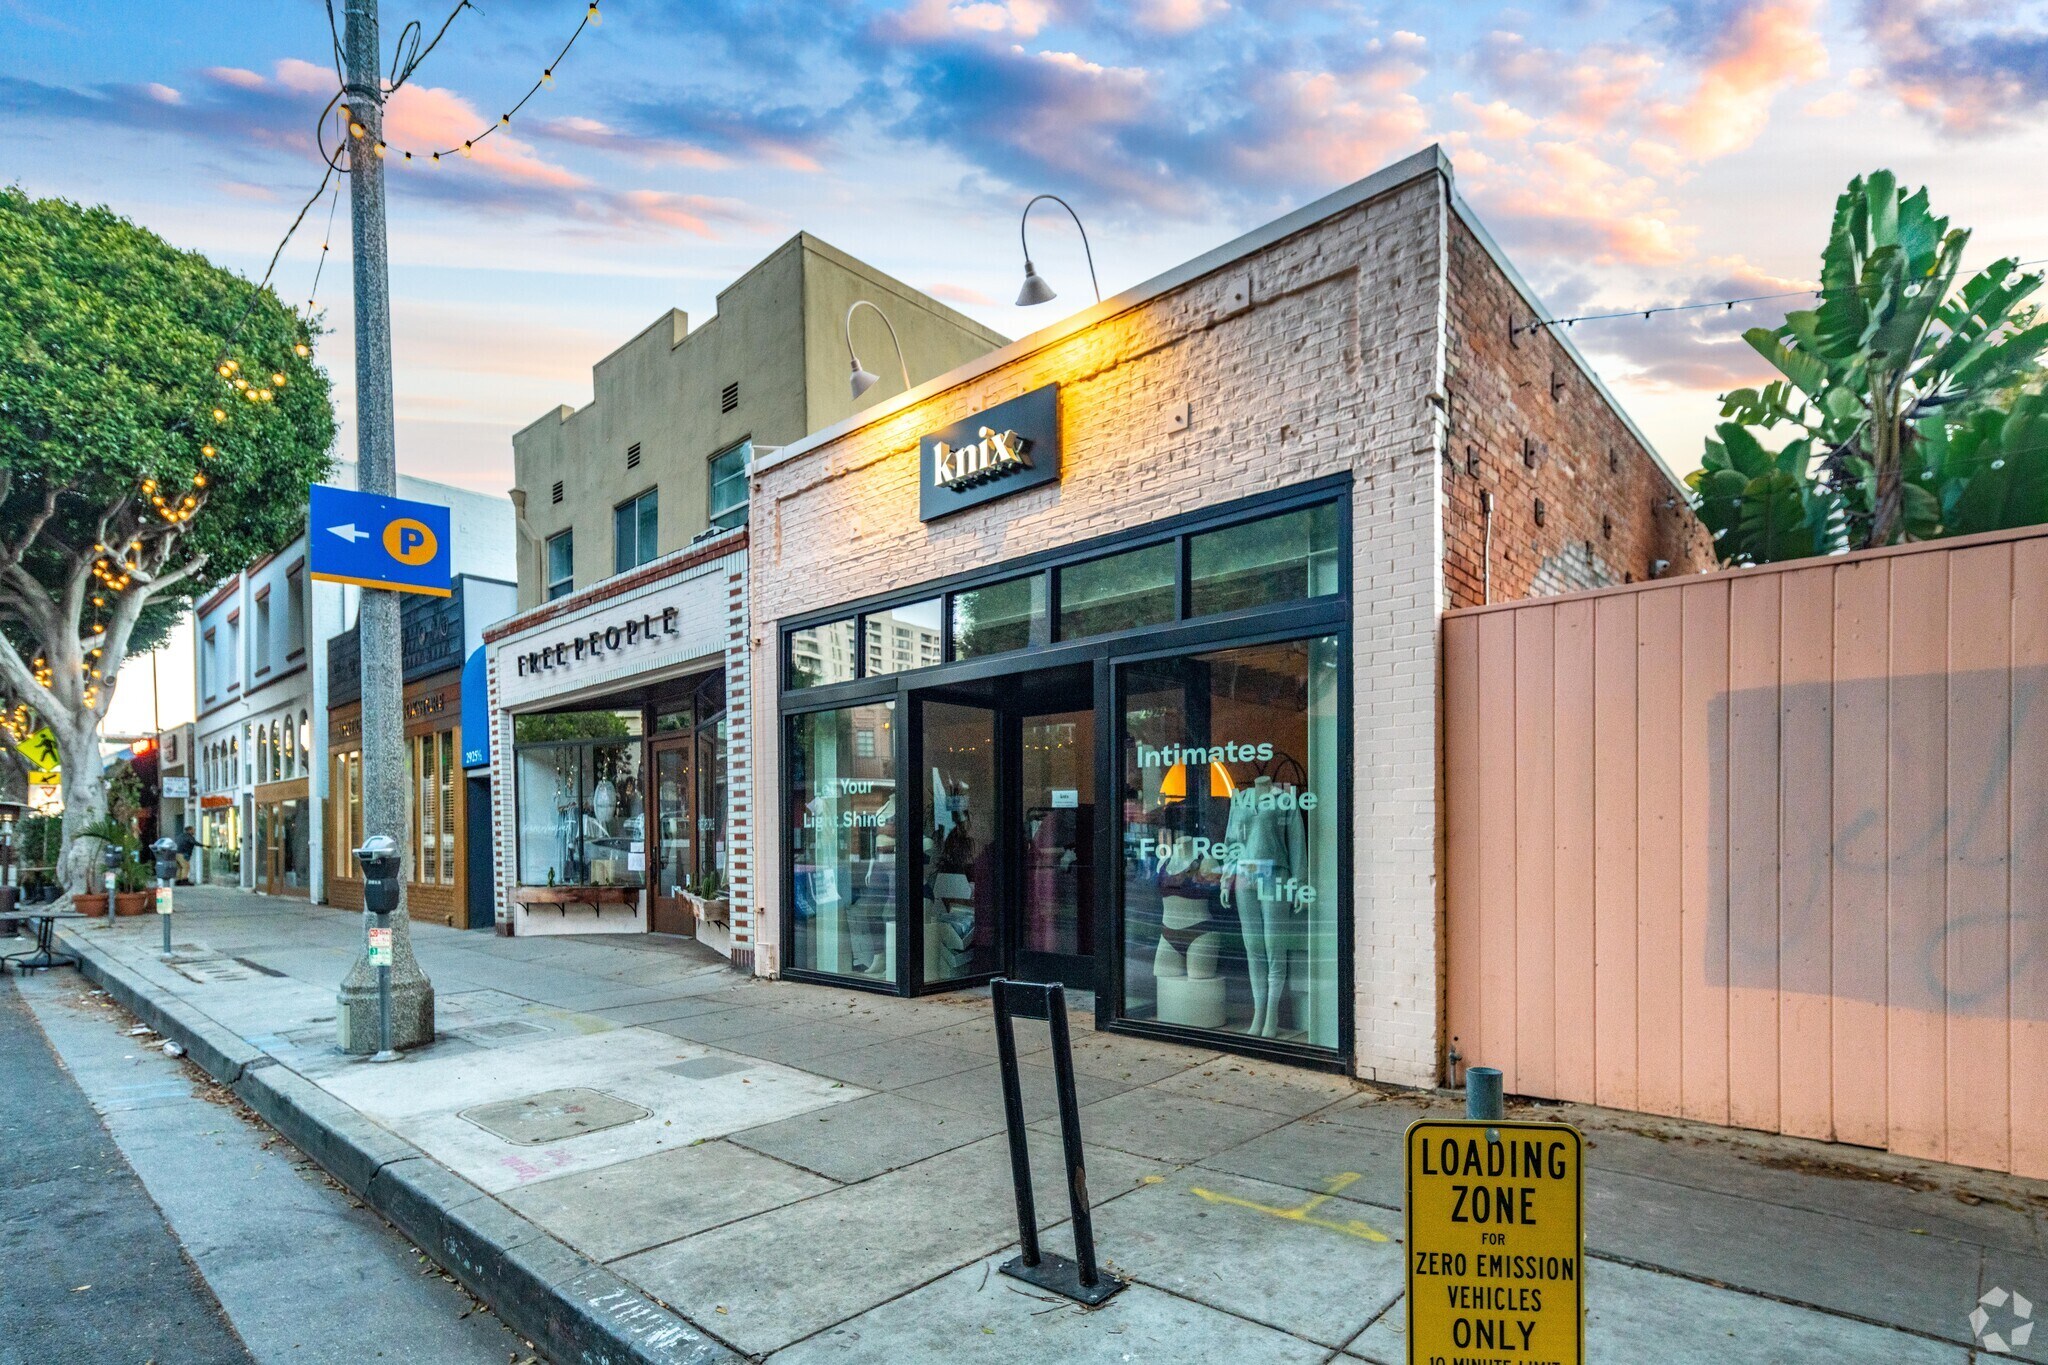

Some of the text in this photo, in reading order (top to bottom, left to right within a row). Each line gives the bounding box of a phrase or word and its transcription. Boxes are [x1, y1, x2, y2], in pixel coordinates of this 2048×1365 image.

[934, 426, 1019, 486] knix
[400, 527, 424, 555] P
[517, 607, 679, 677] FREE PEOPLE
[1137, 741, 1274, 768] Intimates
[840, 778, 874, 795] Your
[1231, 786, 1318, 811] Made
[843, 811, 886, 828] Shine
[1140, 837, 1250, 861] For Rea
[1257, 877, 1317, 903] Life
[1422, 1138, 1566, 1180] LOADING
[1451, 1186, 1537, 1225] ZONE
[1481, 1233, 1506, 1246] FOR
[1416, 1252, 1574, 1281] ZERO EMISSION
[1447, 1285, 1542, 1312] VEHICLES
[1452, 1318, 1536, 1351] ONLY
